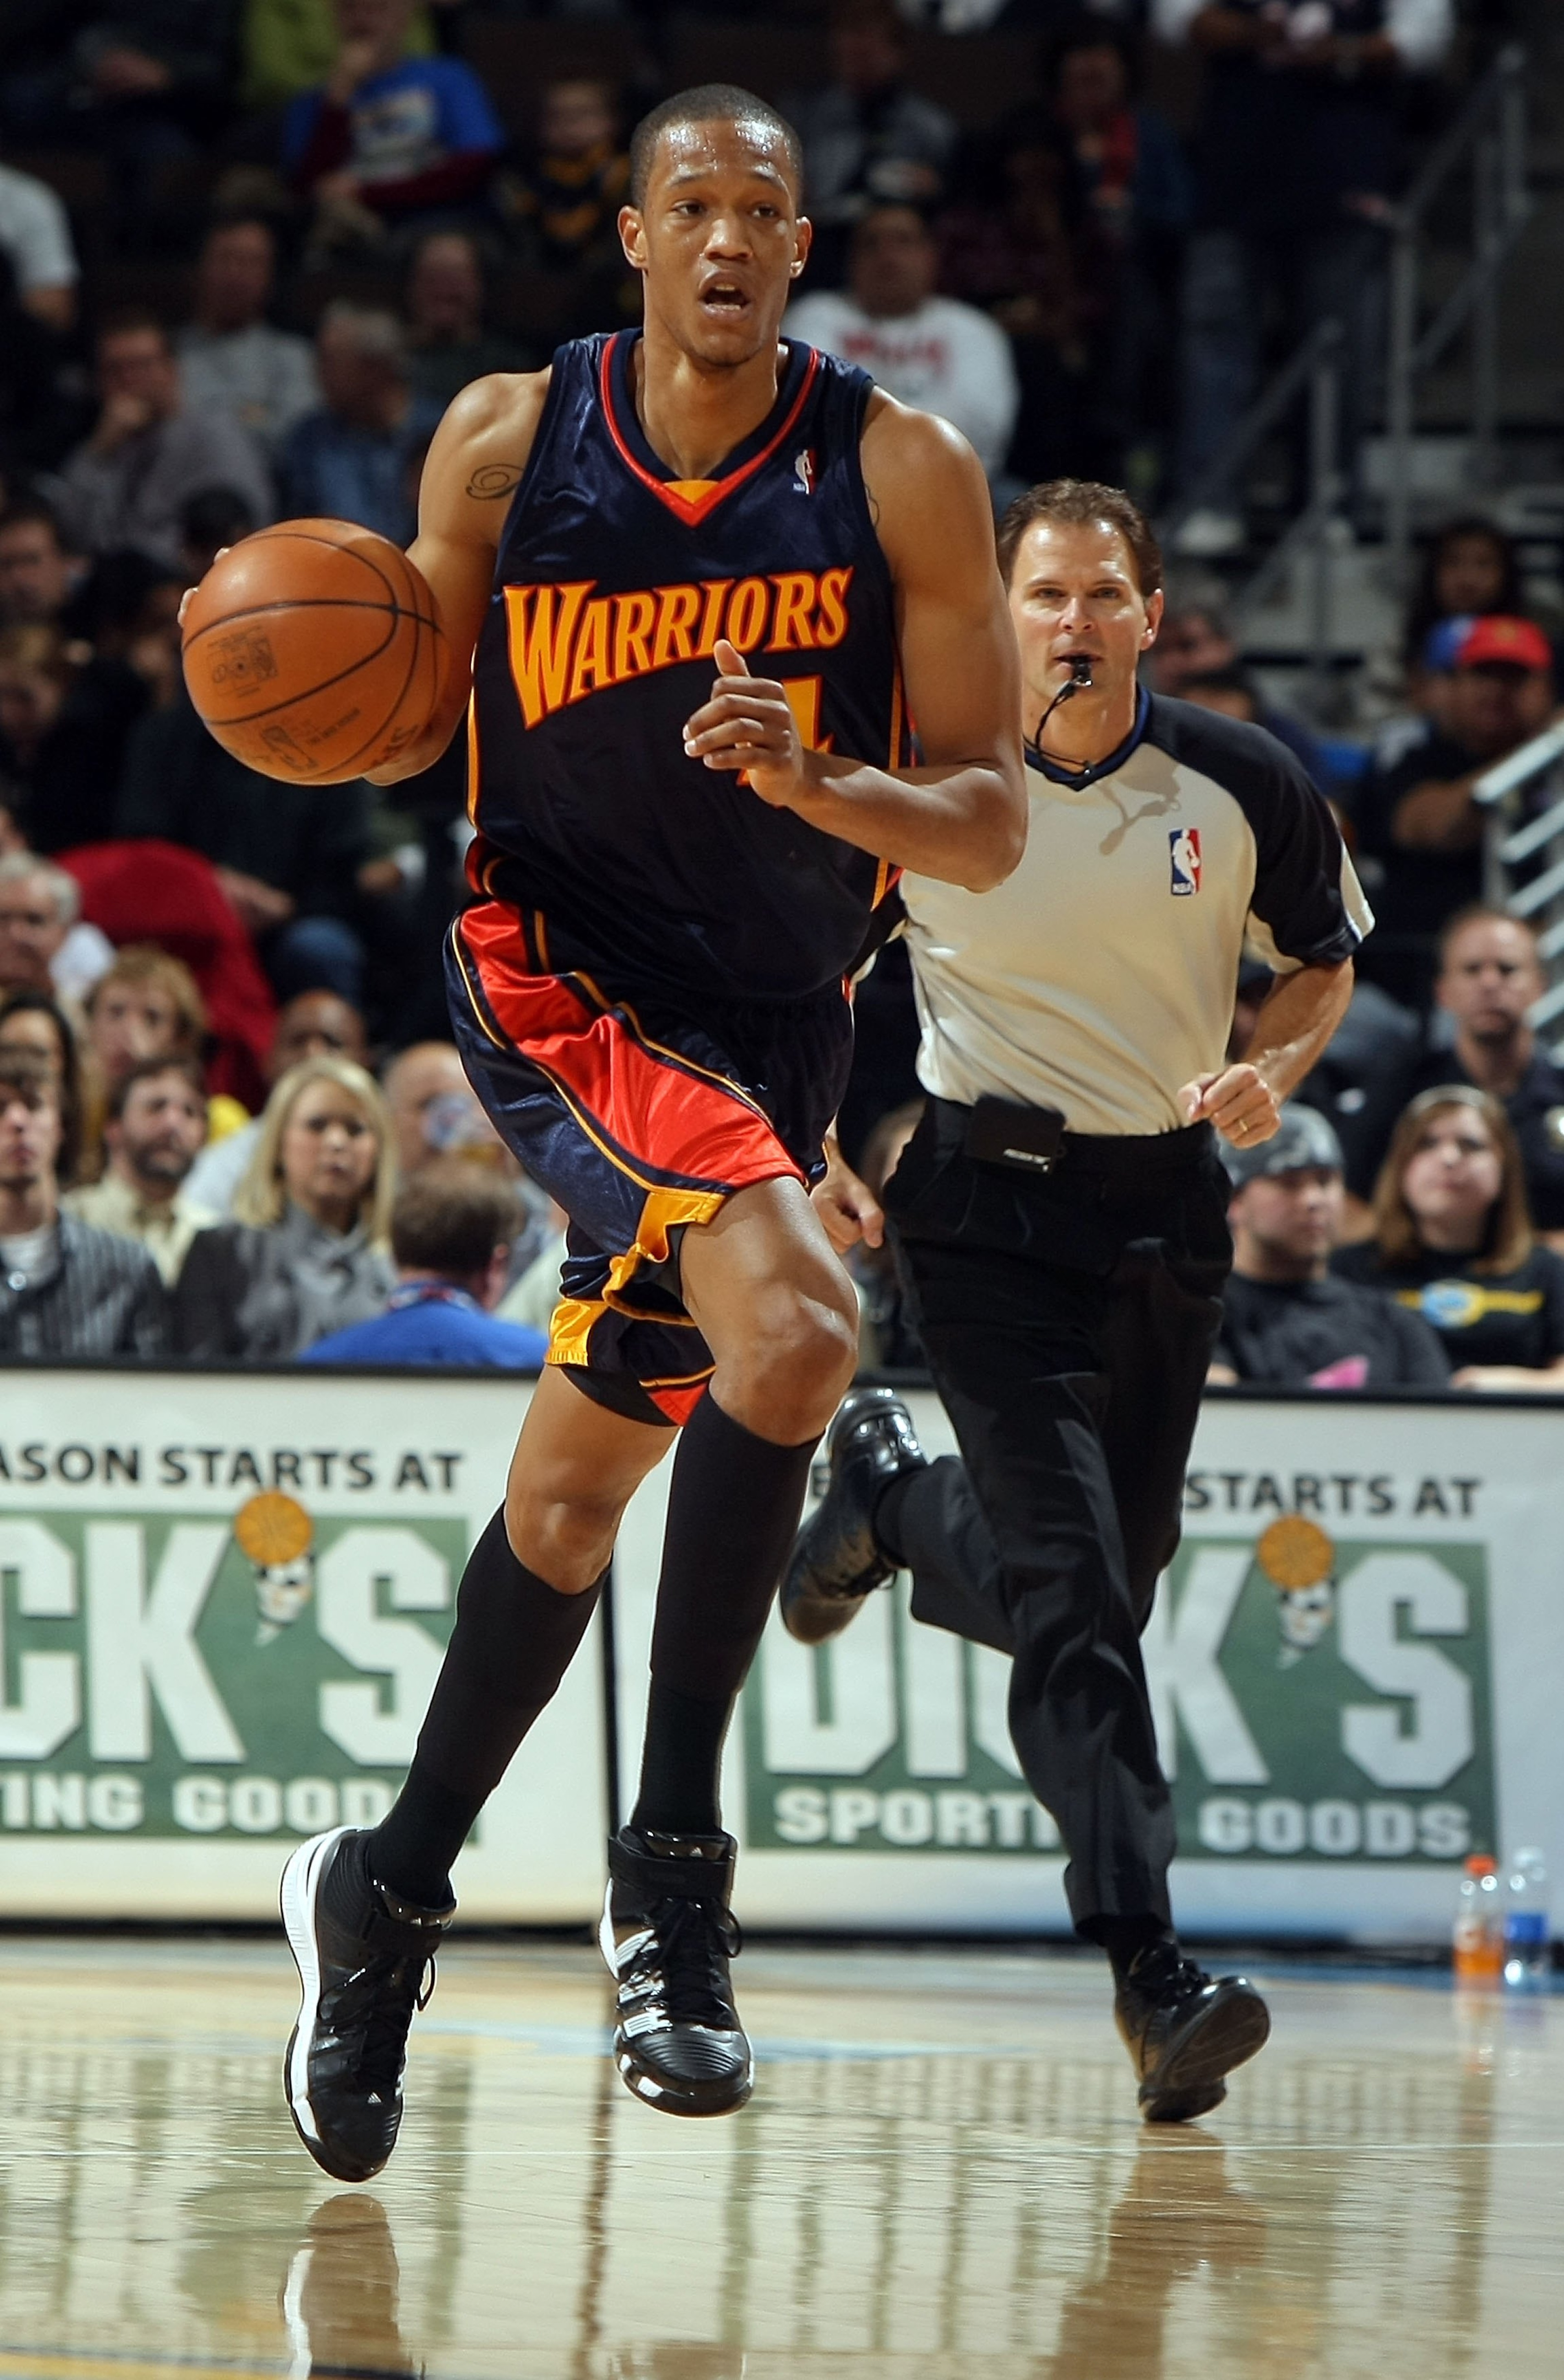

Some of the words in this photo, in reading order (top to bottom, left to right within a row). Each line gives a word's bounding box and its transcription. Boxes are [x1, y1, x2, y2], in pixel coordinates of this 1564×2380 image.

[502, 565, 854, 731] WARRIORS
[162, 1447, 374, 1489] STARTS
[394, 1453, 464, 1490] AT
[1184, 1473, 1396, 1514] STARTS
[1413, 1477, 1483, 1517] AT
[0, 1772, 144, 1831] ING
[1198, 1797, 1470, 1858] GOODS
